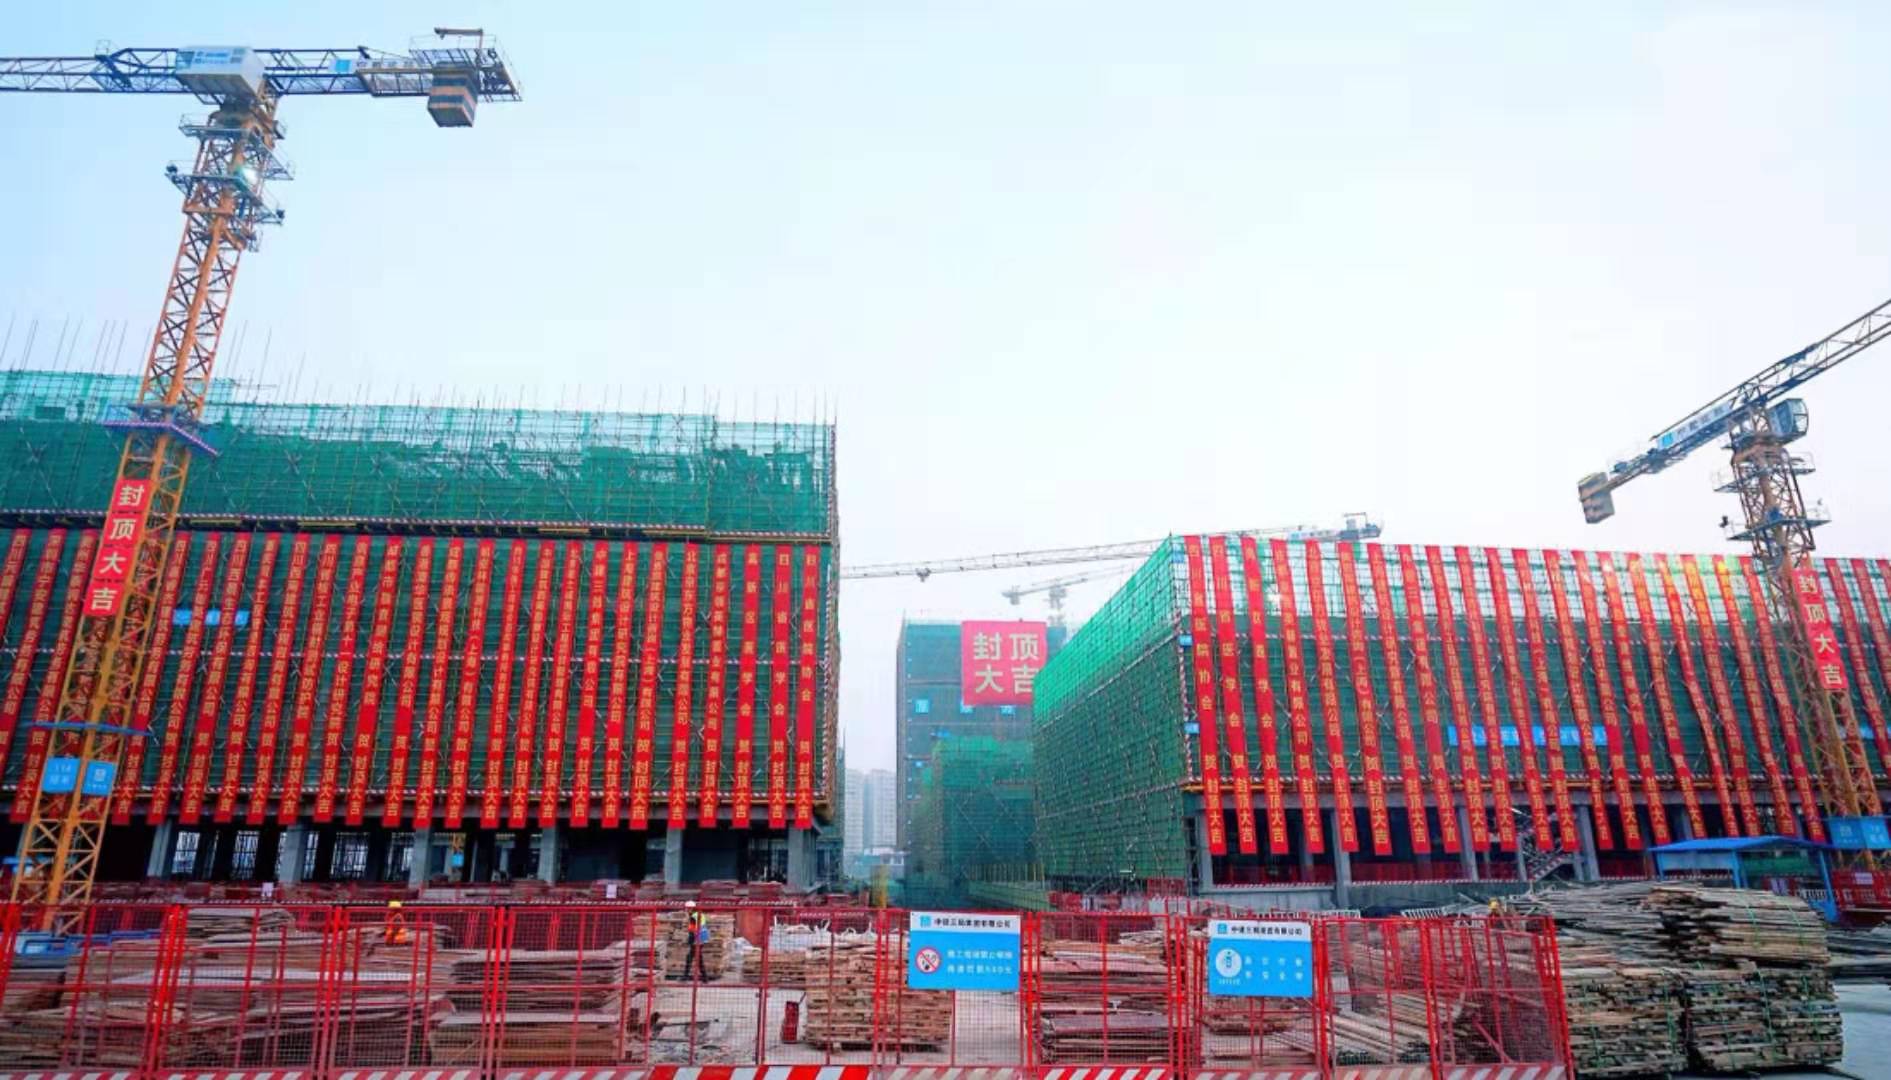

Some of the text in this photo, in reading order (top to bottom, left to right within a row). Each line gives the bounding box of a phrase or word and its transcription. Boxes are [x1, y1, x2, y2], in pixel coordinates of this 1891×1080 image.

[90, 484, 145, 612] 封顶大吉
[973, 632, 1039, 661] 封顶
[1799, 575, 1842, 685] 封顶大吉
[975, 663, 1039, 694] 大吉
[18, 755, 39, 813] 封顶大吉
[120, 755, 138, 813] 封顶大吉
[154, 755, 172, 812] 封顶大吉
[186, 755, 204, 813] 封顶大吉
[220, 754, 239, 811] 封顶大吉
[251, 755, 270, 813] 封顶大吉
[282, 755, 302, 813] 封顶大吉
[318, 755, 336, 813] 封顶大吉
[348, 757, 366, 815] 封顶大吉
[387, 758, 403, 816] 封顶大吉
[418, 760, 433, 819] 封顶大吉
[449, 760, 464, 819] 封顶大吉
[483, 760, 500, 819] 封顶大吉
[512, 760, 528, 819] 封顶大吉
[541, 760, 557, 818] 封顶大吉
[571, 759, 589, 817] 封顶大吉
[603, 759, 617, 817] 封顶大吉
[633, 761, 648, 820] 封顶大吉
[673, 761, 687, 820] 封顶大吉
[700, 760, 718, 817] 封顶大吉
[733, 761, 749, 818] 封顶大吉
[768, 761, 784, 819] 封顶大吉
[795, 762, 812, 819] 封顶大吉
[1207, 779, 1222, 843] 封顶大吉
[1237, 778, 1253, 842] 封顶大吉
[1268, 778, 1283, 843] 封顶大吉
[1303, 777, 1319, 841] 封顶大吉
[1338, 778, 1353, 841] 封顶大吉
[1371, 779, 1387, 843] 封顶大吉
[1408, 778, 1425, 842] 封顶大吉
[1438, 778, 1455, 841] 封顶大吉
[1469, 779, 1486, 842] 封顶大吉
[1495, 778, 1512, 841] 封顶大吉
[1533, 778, 1548, 841] 封顶大吉
[1559, 779, 1574, 841] 封顶大吉
